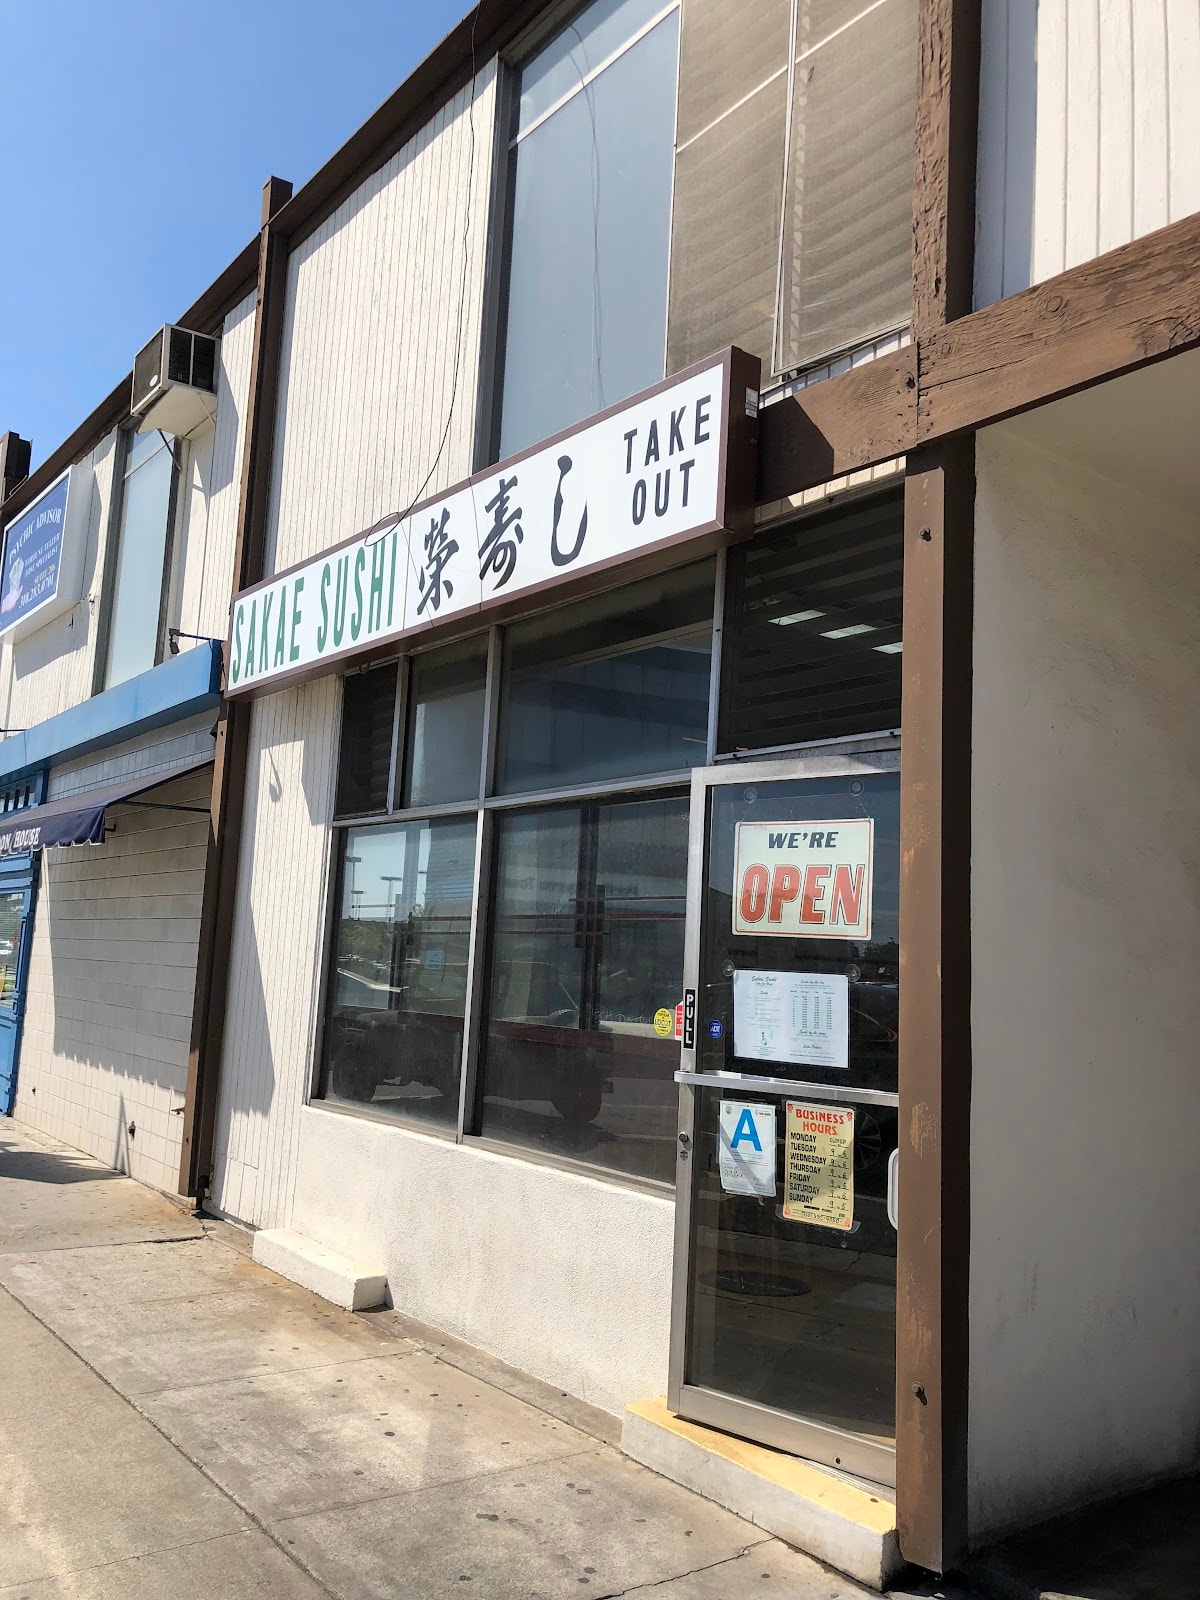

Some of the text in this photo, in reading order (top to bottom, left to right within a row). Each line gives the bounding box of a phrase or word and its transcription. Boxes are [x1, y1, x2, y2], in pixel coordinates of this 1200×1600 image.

[624, 394, 711, 474] TAKE
[632, 459, 695, 525] OUT
[9, 508, 62, 565] PSYCHIC ADVISOR
[232, 532, 398, 683] SAKAE SUSHI
[13, 827, 41, 848] HOUSE
[768, 831, 839, 849] WE'RE
[740, 863, 865, 925] OPEN
[685, 994, 694, 1044] PULL
[710, 1025, 720, 1033] ADT
[731, 1109, 763, 1152] A
[802, 1121, 837, 1136] HOURS
[790, 1132, 816, 1143] MONDAY
[790, 1142, 816, 1153] TUESDAY
[790, 1152, 827, 1165] WEDNESDAY
[790, 1162, 821, 1174] THURSDAY
[789, 1172, 811, 1183] FRIDAY
[789, 1183, 820, 1195] SATURDAY
[789, 1193, 813, 1204] SUNDAY
